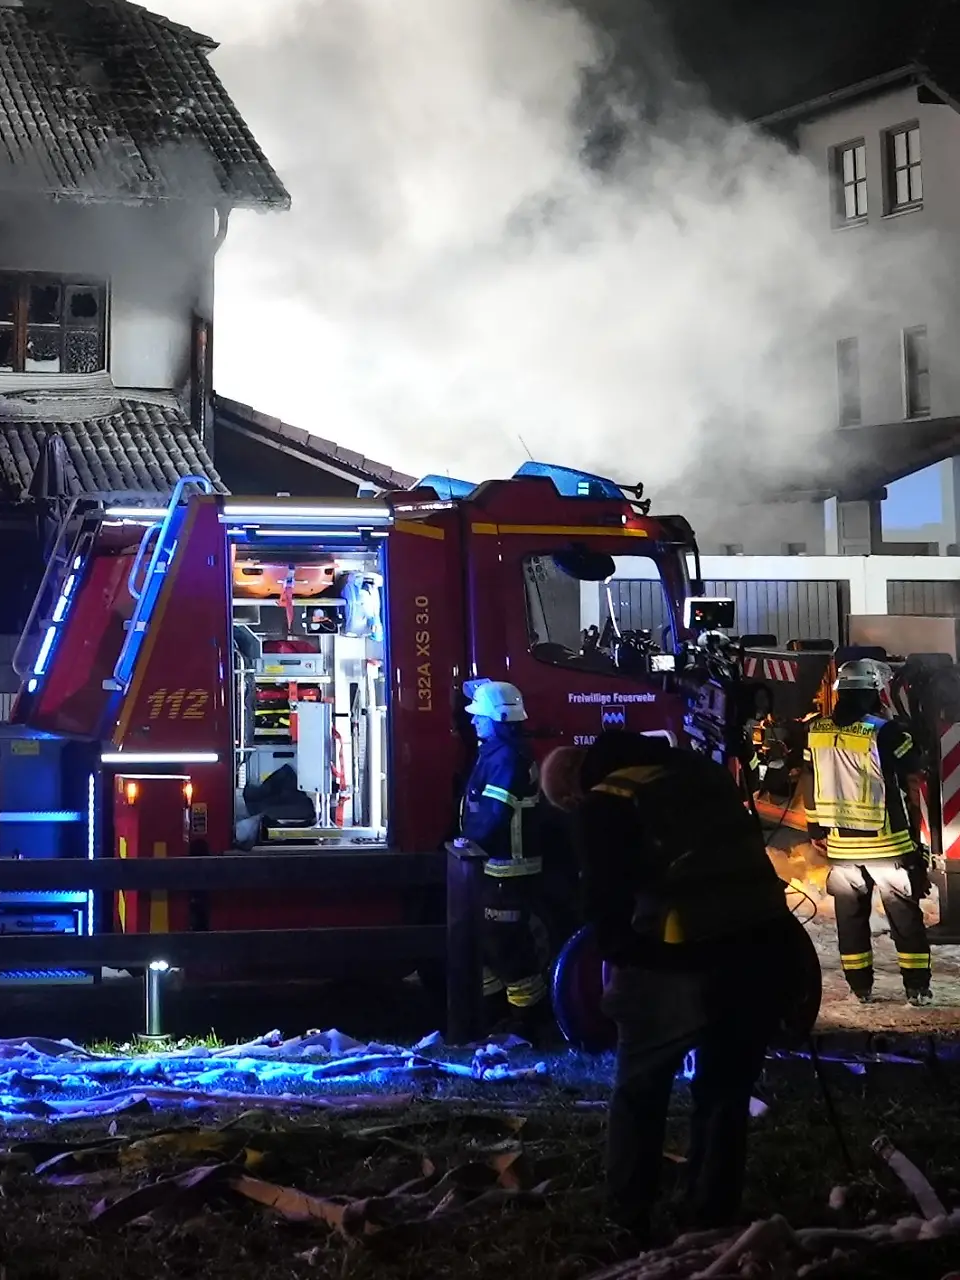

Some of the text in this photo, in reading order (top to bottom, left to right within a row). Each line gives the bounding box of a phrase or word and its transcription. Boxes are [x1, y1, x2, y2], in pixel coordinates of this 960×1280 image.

[415, 595, 432, 711] L32A XS 3.0
[147, 688, 209, 719] 112
[568, 692, 656, 704] Freiwillige Feuerwehr
[573, 735, 598, 746] STAD
